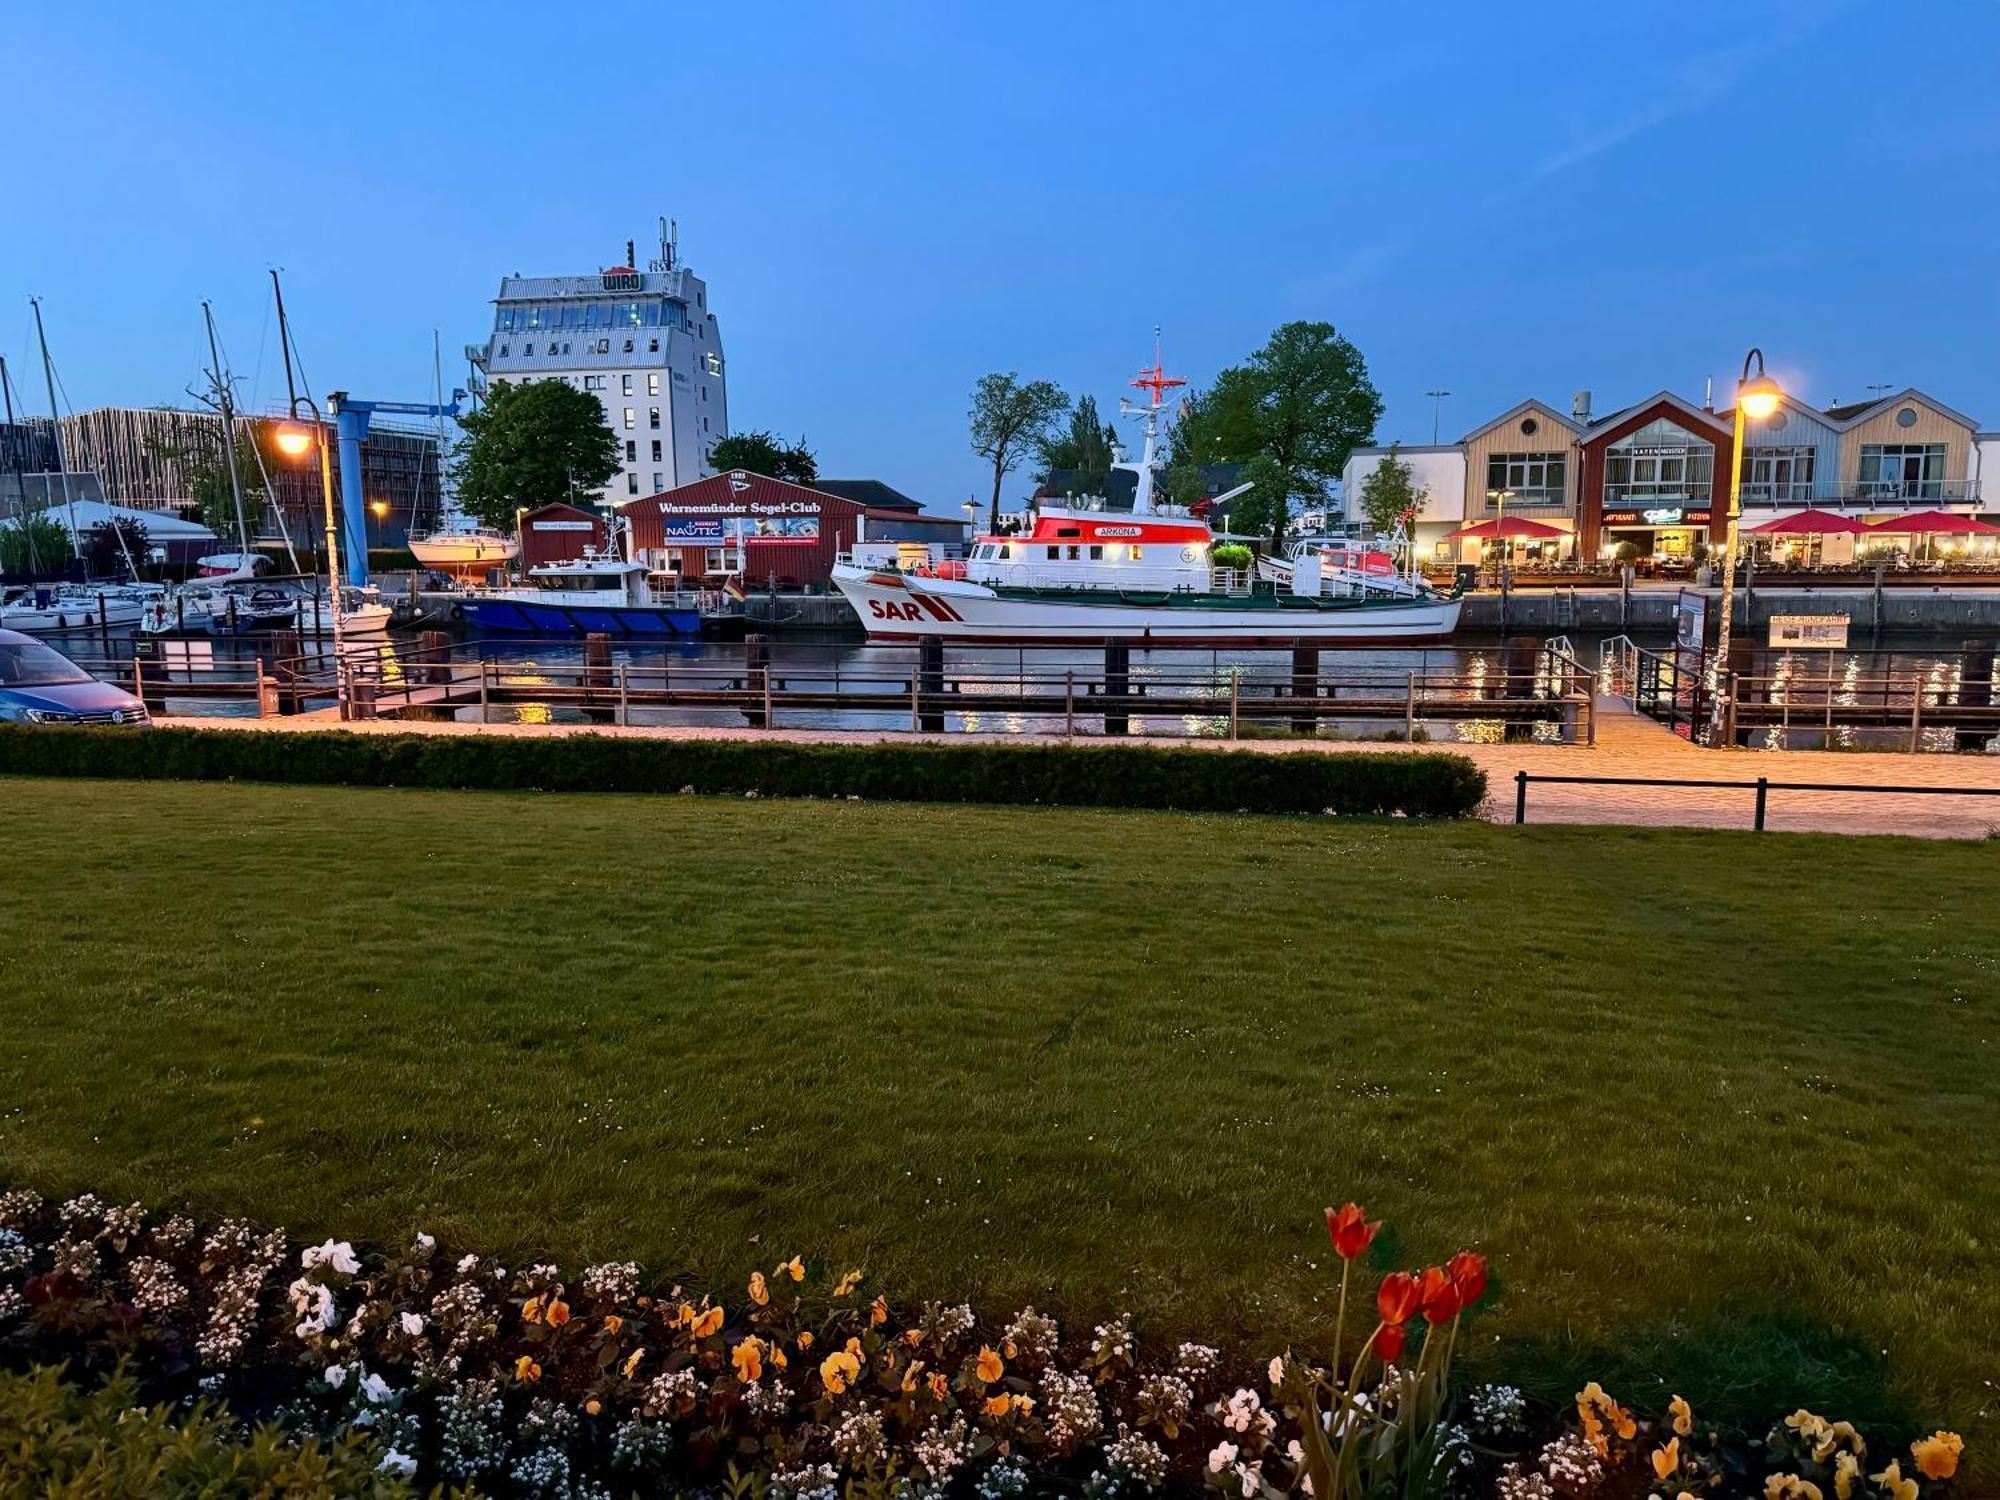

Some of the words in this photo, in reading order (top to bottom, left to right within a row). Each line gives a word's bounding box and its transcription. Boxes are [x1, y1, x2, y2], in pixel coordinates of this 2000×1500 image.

[603, 274, 639, 290] WIRO
[659, 502, 747, 513] Warnemünder
[751, 502, 821, 515] Segel-Club
[666, 526, 721, 536] NAUTIC
[1101, 527, 1137, 536] ARKONA
[868, 599, 926, 621] SAR
